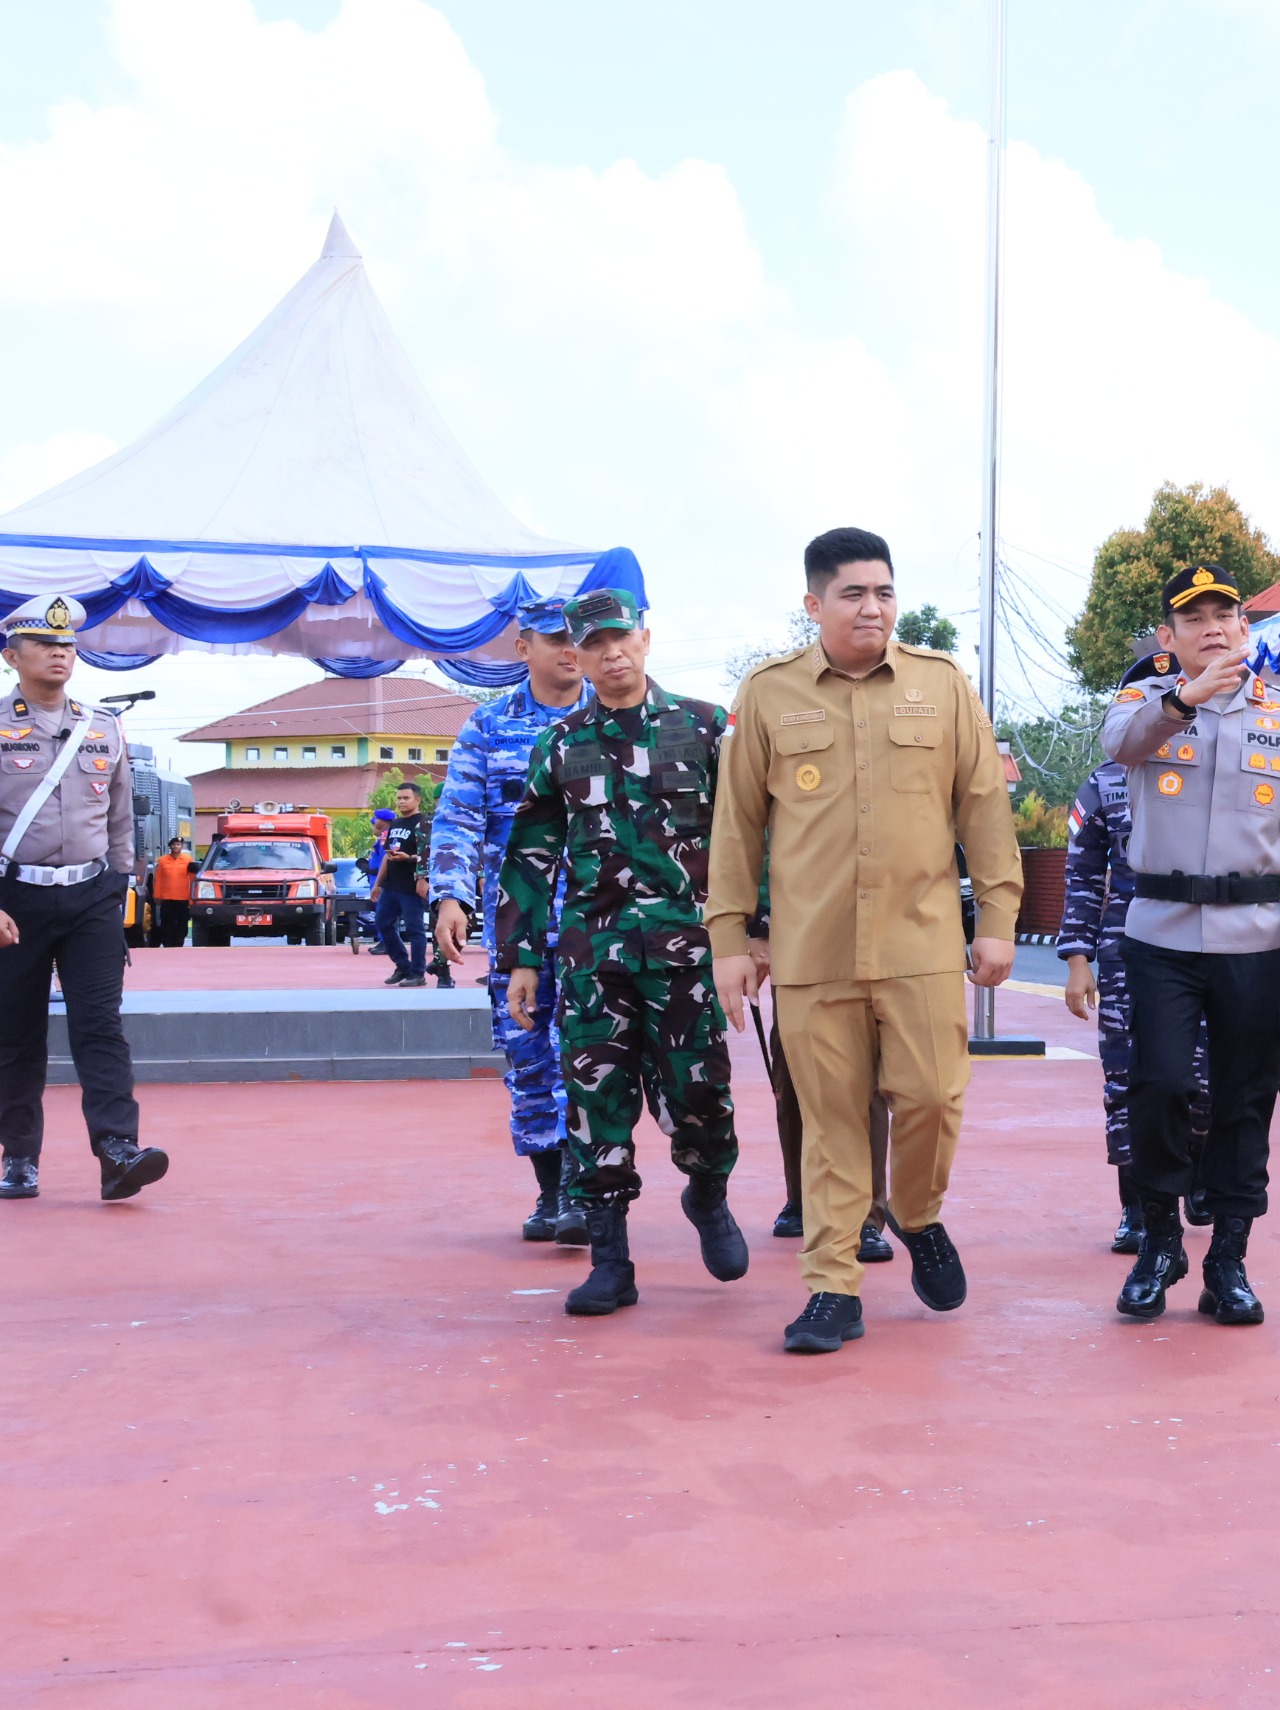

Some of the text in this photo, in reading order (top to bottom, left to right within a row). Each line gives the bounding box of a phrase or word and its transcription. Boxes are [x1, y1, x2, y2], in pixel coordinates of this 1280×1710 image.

[78, 744, 109, 754] POLRI
[1105, 791, 1128, 802] TIM
[389, 828, 411, 840] TEXAS
